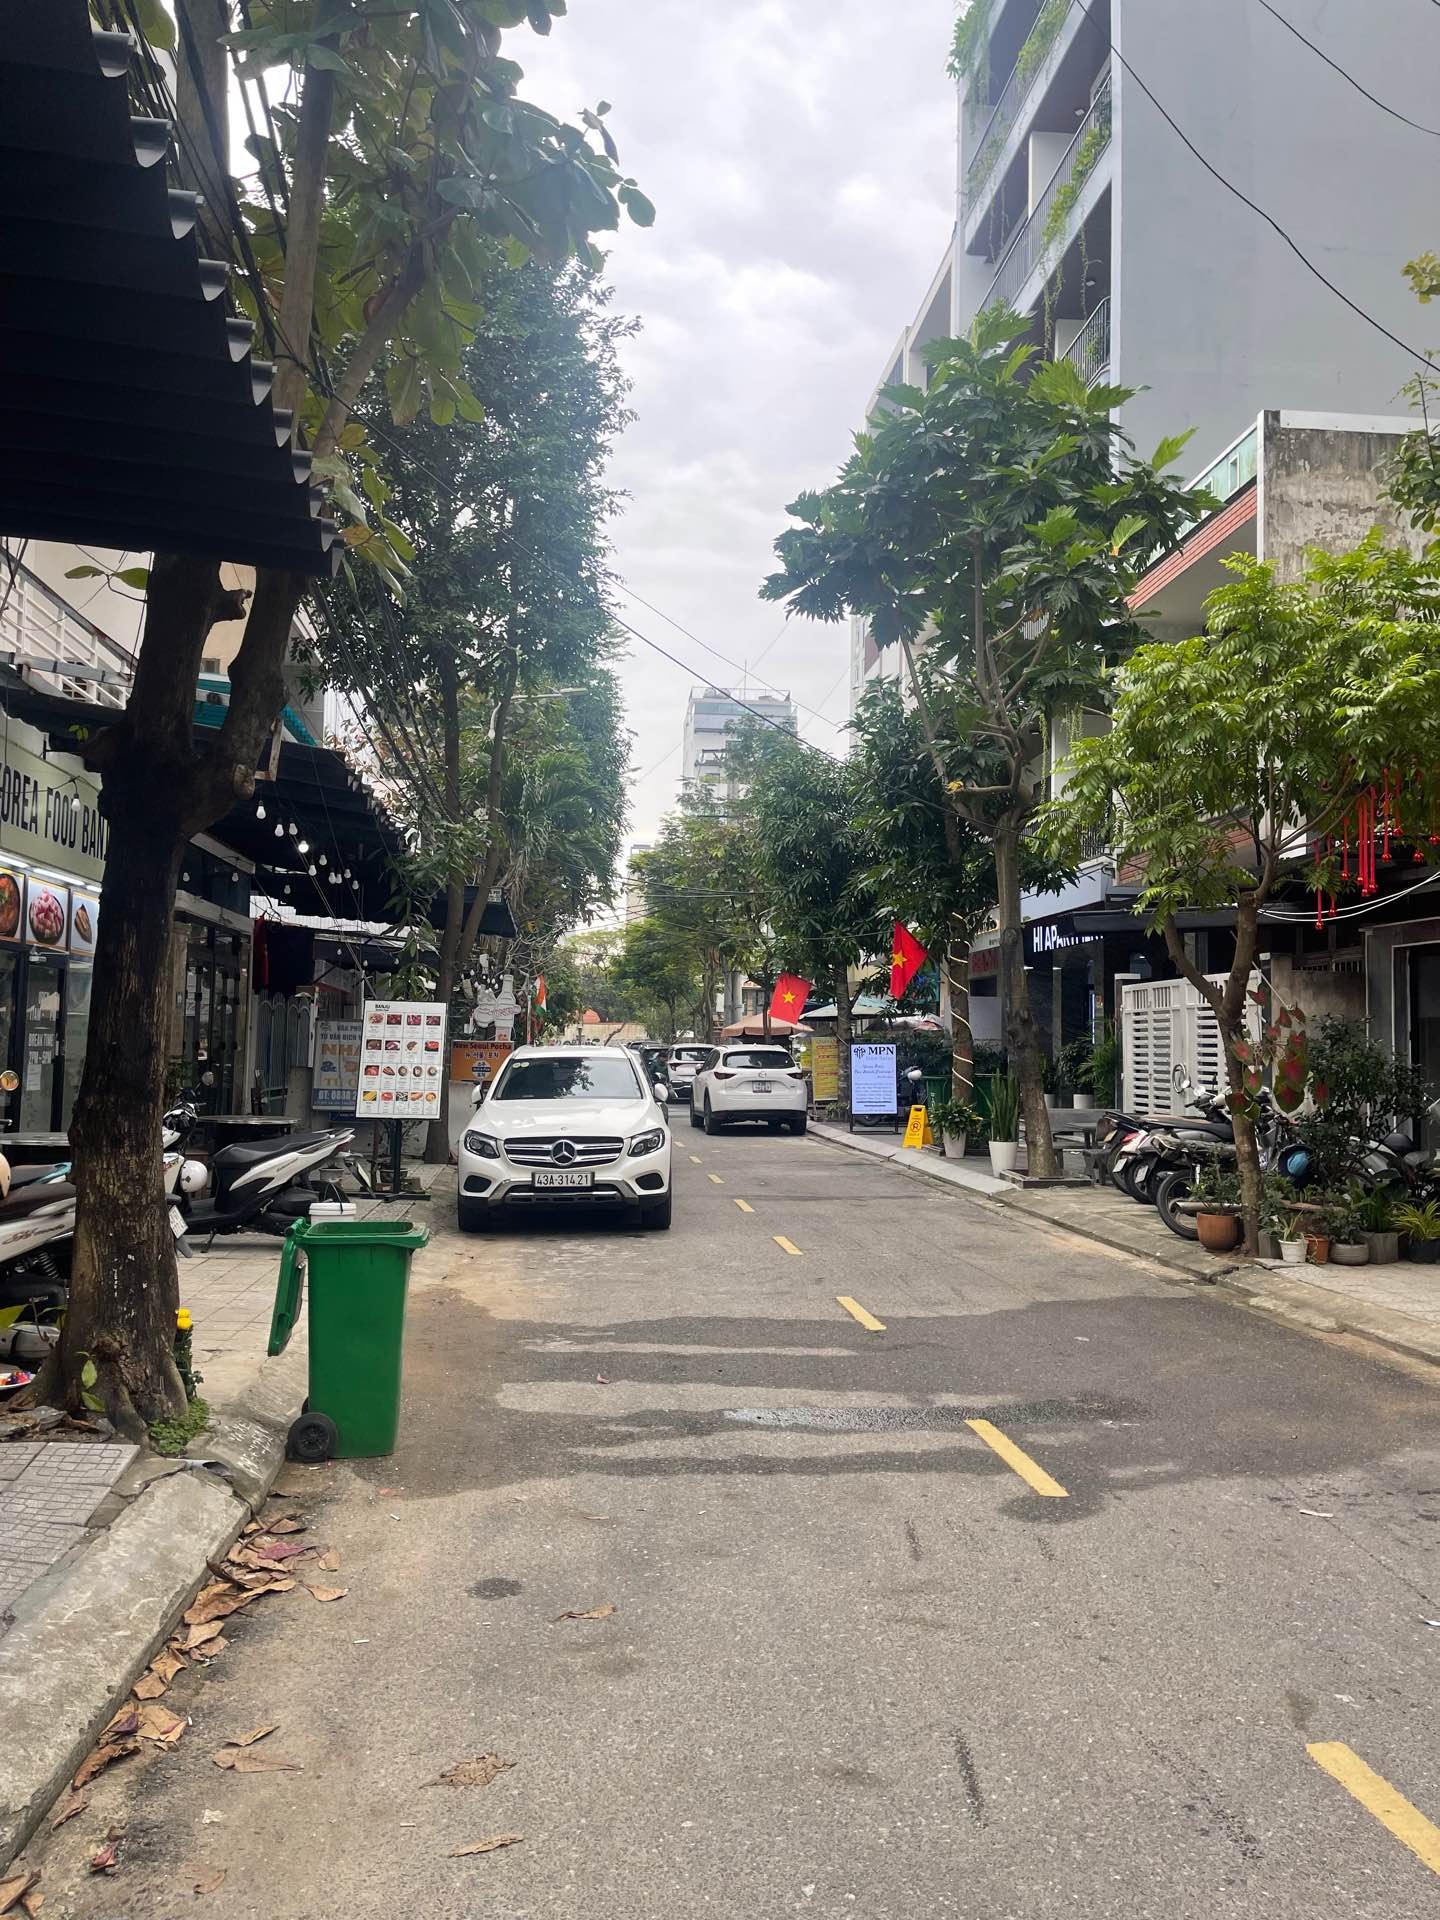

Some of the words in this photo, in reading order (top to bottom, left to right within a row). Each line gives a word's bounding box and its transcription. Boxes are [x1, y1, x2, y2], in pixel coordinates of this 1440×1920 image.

[0, 763, 38, 834] OREA
[45, 787, 77, 848] FOOD
[868, 1046, 895, 1055] MPN
